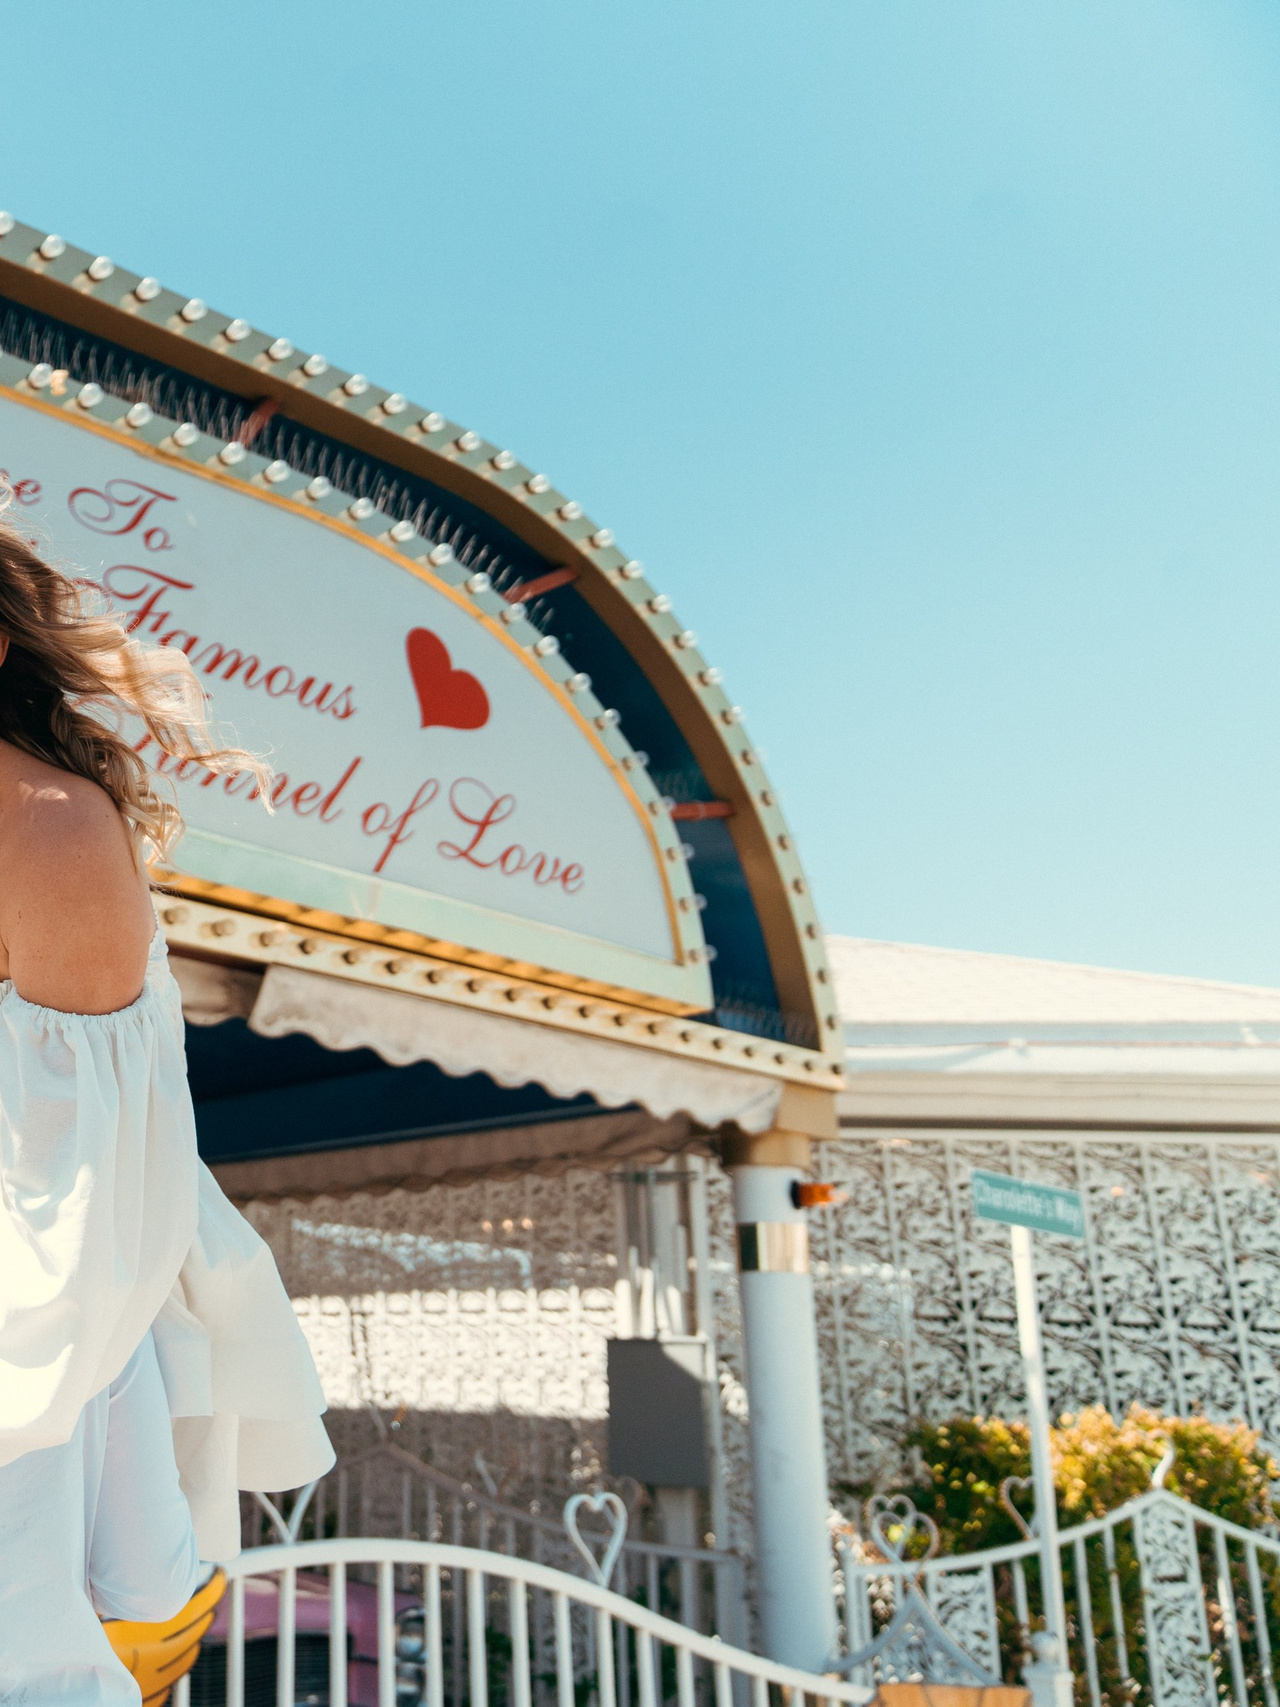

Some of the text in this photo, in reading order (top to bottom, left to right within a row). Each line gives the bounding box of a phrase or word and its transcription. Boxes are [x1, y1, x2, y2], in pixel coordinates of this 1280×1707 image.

[68, 478, 178, 552] To
[75, 564, 357, 720] Famous
[361, 778, 439, 873] of
[437, 777, 584, 894] Love
